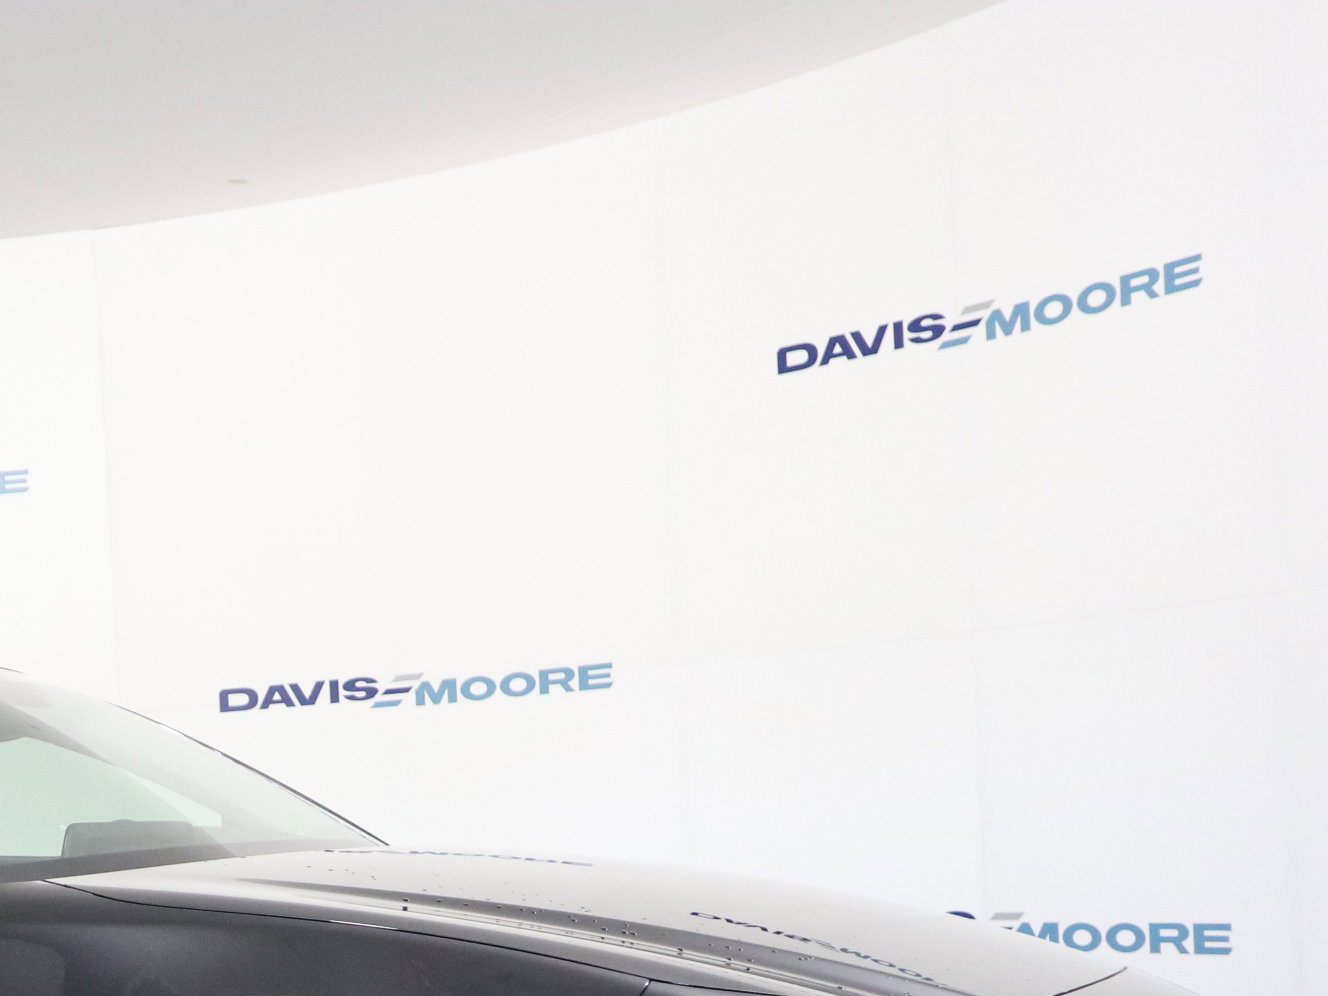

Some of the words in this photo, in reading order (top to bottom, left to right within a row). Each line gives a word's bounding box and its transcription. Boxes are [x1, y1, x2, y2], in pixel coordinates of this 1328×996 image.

[776, 311, 948, 377] DAVIS
[984, 252, 1204, 342] MOORE
[218, 676, 380, 714] DAVIS
[413, 661, 614, 707] MOORE
